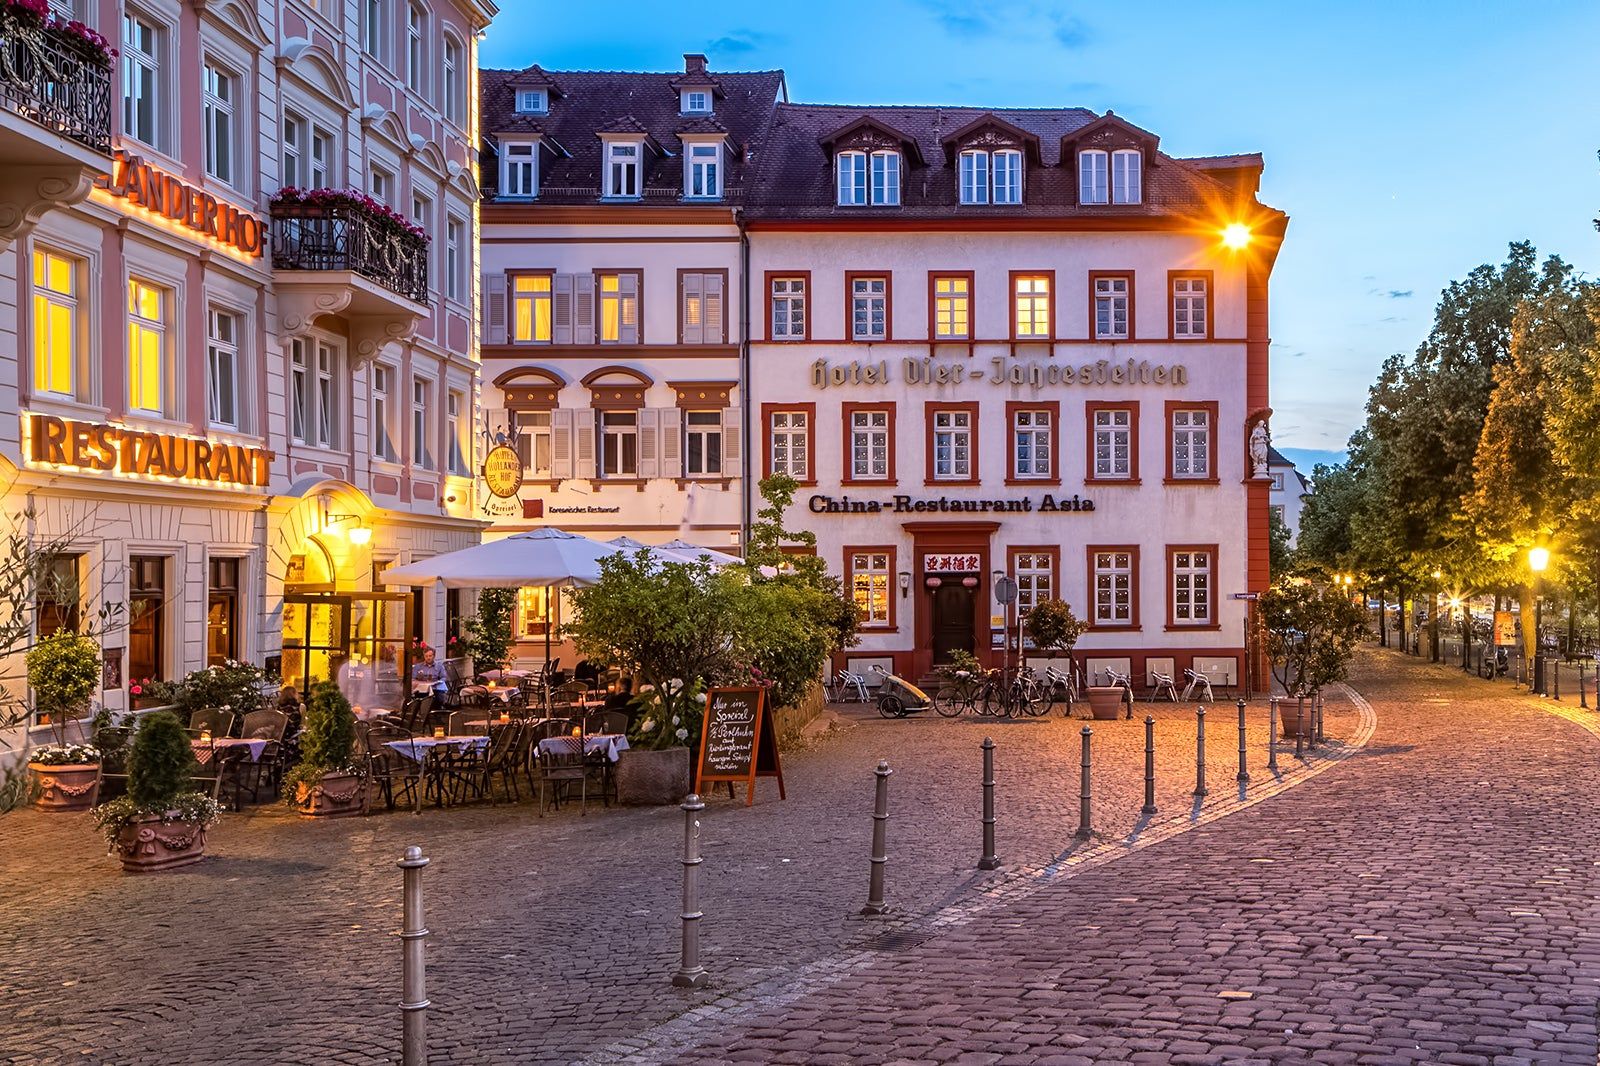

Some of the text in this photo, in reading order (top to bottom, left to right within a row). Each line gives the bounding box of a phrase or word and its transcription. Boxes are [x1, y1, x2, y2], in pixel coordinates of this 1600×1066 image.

[810, 356, 1188, 390] Hotel Vier-Jahreszeiten
[30, 414, 275, 487] RESTAURANT
[548, 505, 620, 514] Koreanisches Restaurant
[808, 494, 1096, 513] China-Restaurant Asia
